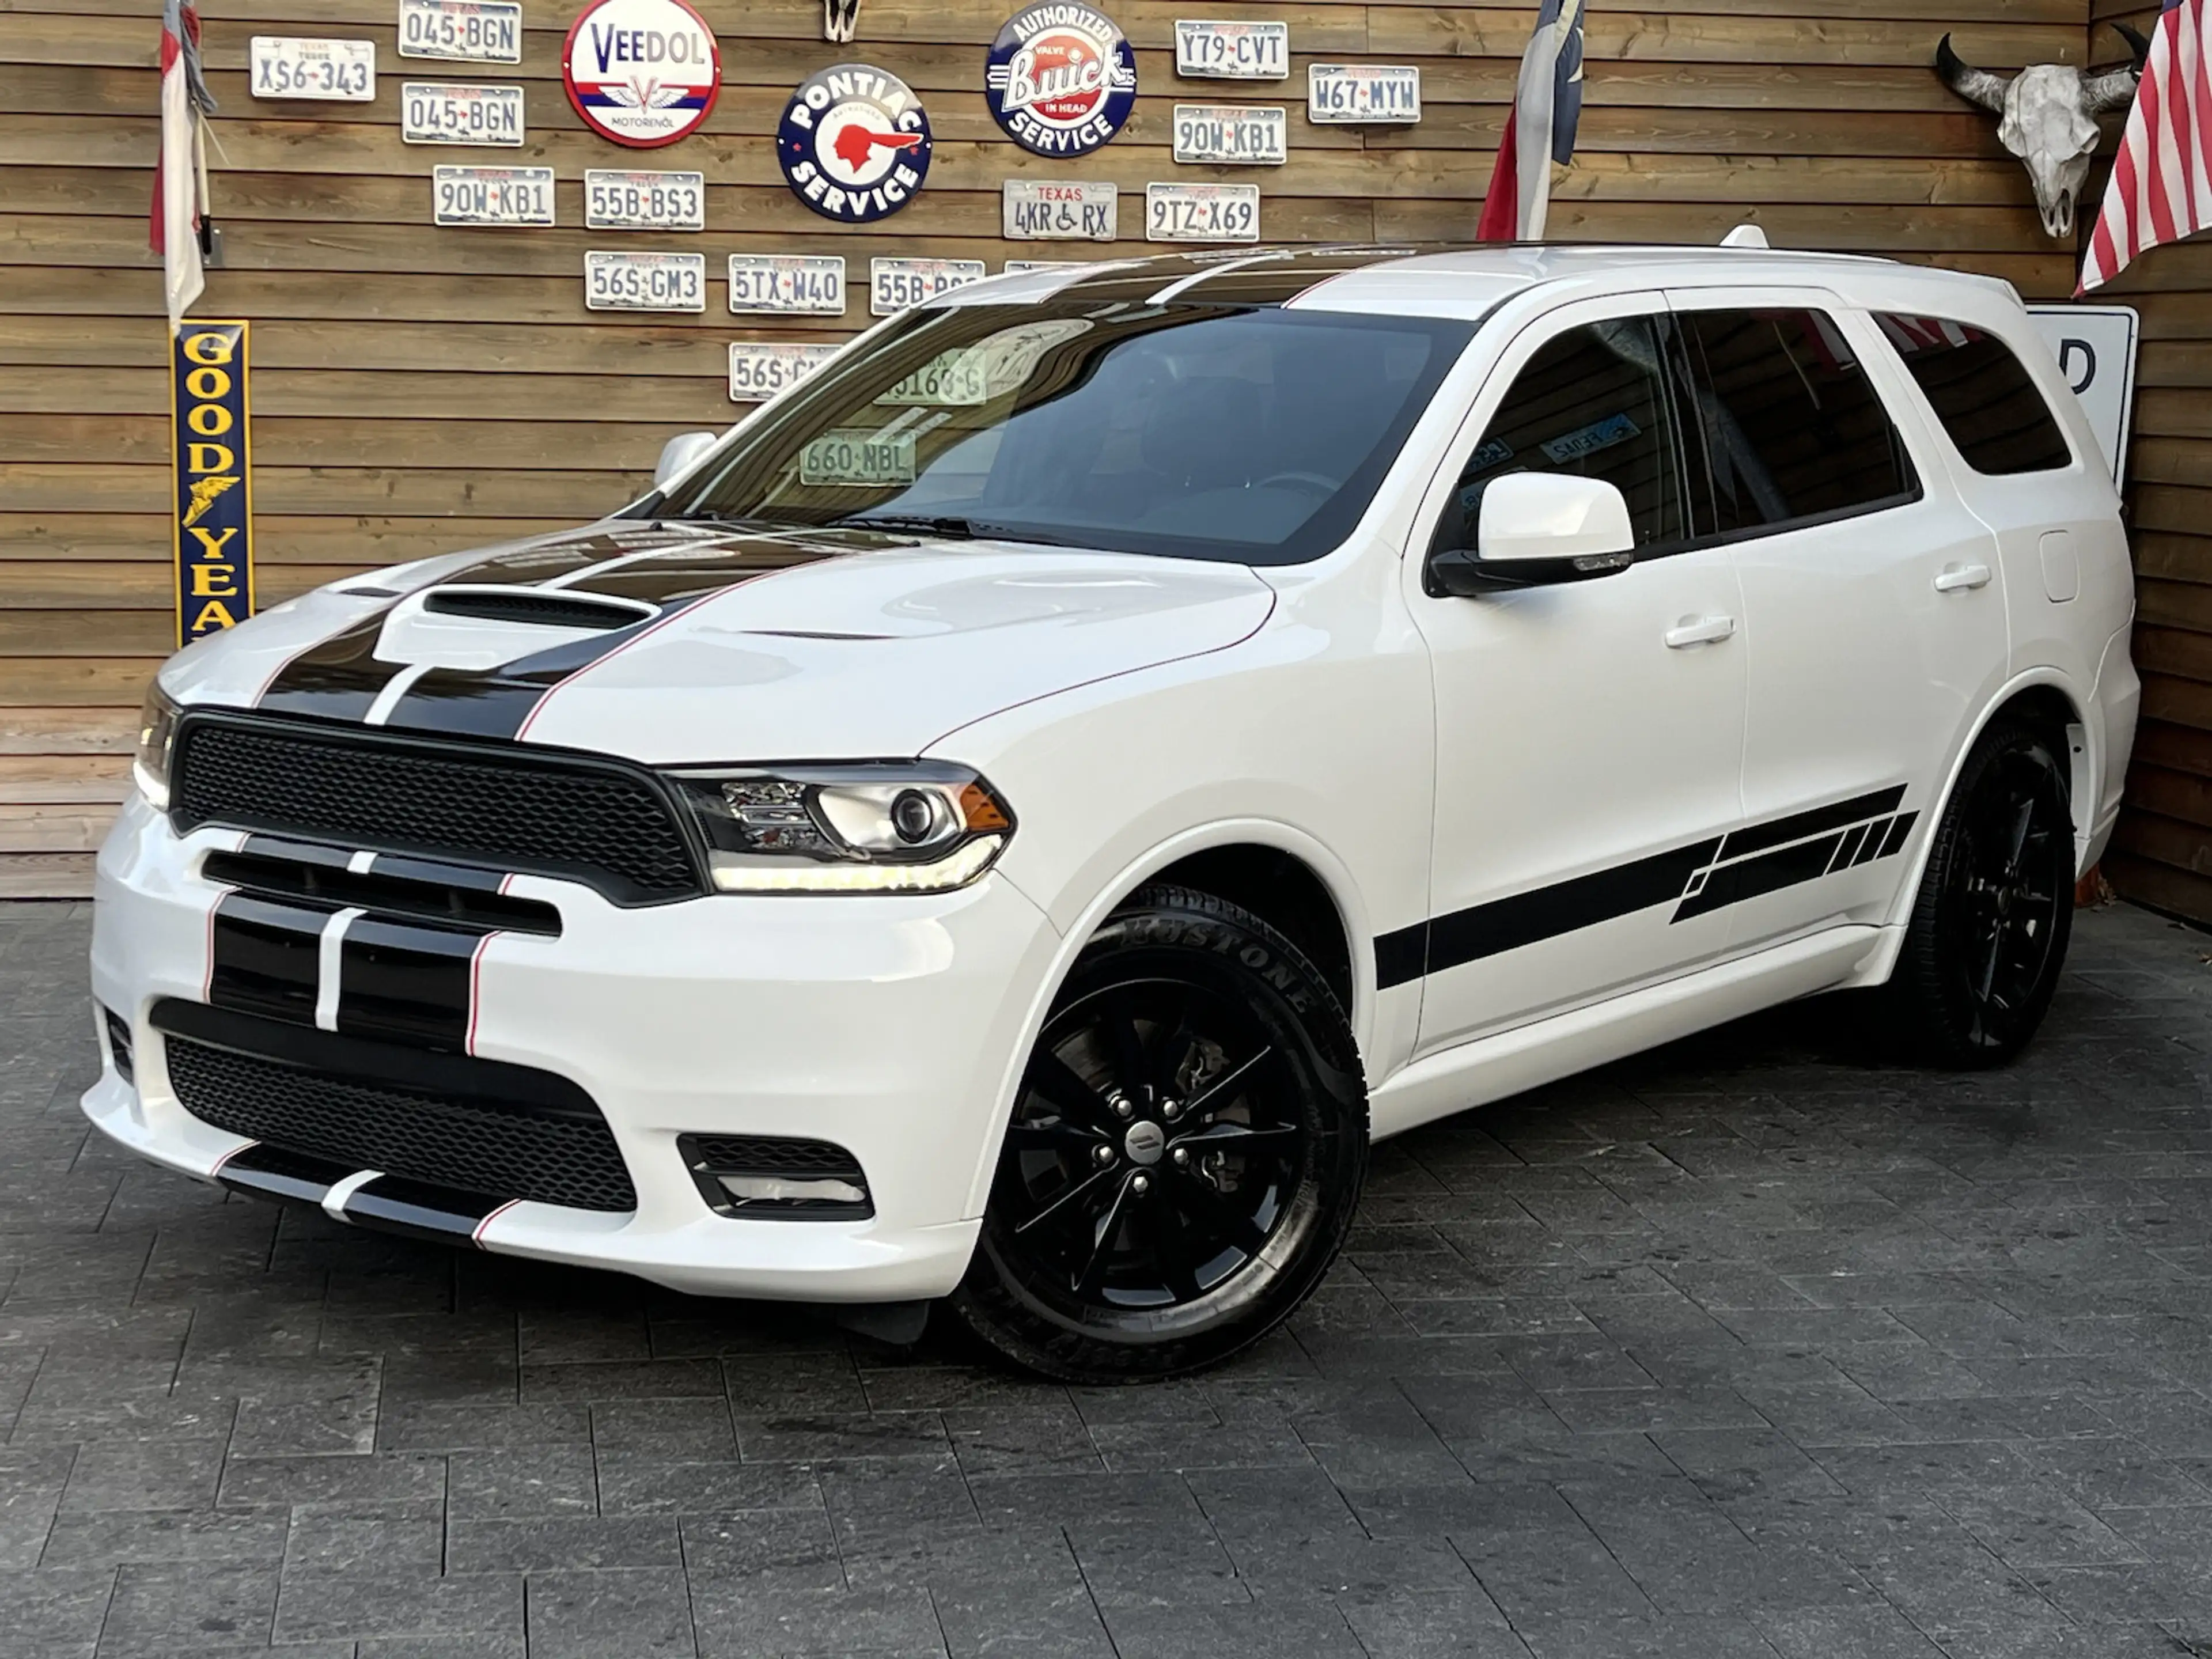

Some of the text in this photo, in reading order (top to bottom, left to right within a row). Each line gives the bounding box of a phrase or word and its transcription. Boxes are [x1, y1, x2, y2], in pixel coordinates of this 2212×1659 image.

[407, 13, 513, 50] 045 BGN
[1012, 5, 1113, 43] AUTHORIZED
[590, 23, 705, 74] VEEDOL
[1183, 35, 1281, 64] Y79 CVT
[259, 59, 367, 92] XS6 343
[1001, 41, 1127, 112] Buick
[790, 72, 922, 132] PONTIAC
[1045, 104, 1088, 113] IN HEAD
[1316, 80, 1359, 108] W67
[411, 100, 516, 131] 045 BGN
[1009, 112, 1113, 151] SERVICE
[1234, 123, 1278, 153] KB1
[441, 183, 546, 214] 90W KB1
[592, 187, 697, 217] 55B BS3
[791, 161, 919, 215] SERVICE
[1038, 187, 1083, 201] TEXAS
[1016, 202, 1107, 233] 4KR RX
[1154, 200, 1252, 230] 9TZ X69
[594, 268, 697, 298] 56S GM3
[736, 271, 837, 301] 5TX W40
[737, 358, 782, 388] 56S
[808, 444, 906, 471] 660 NBL
[183, 332, 238, 642] GOODYEA
